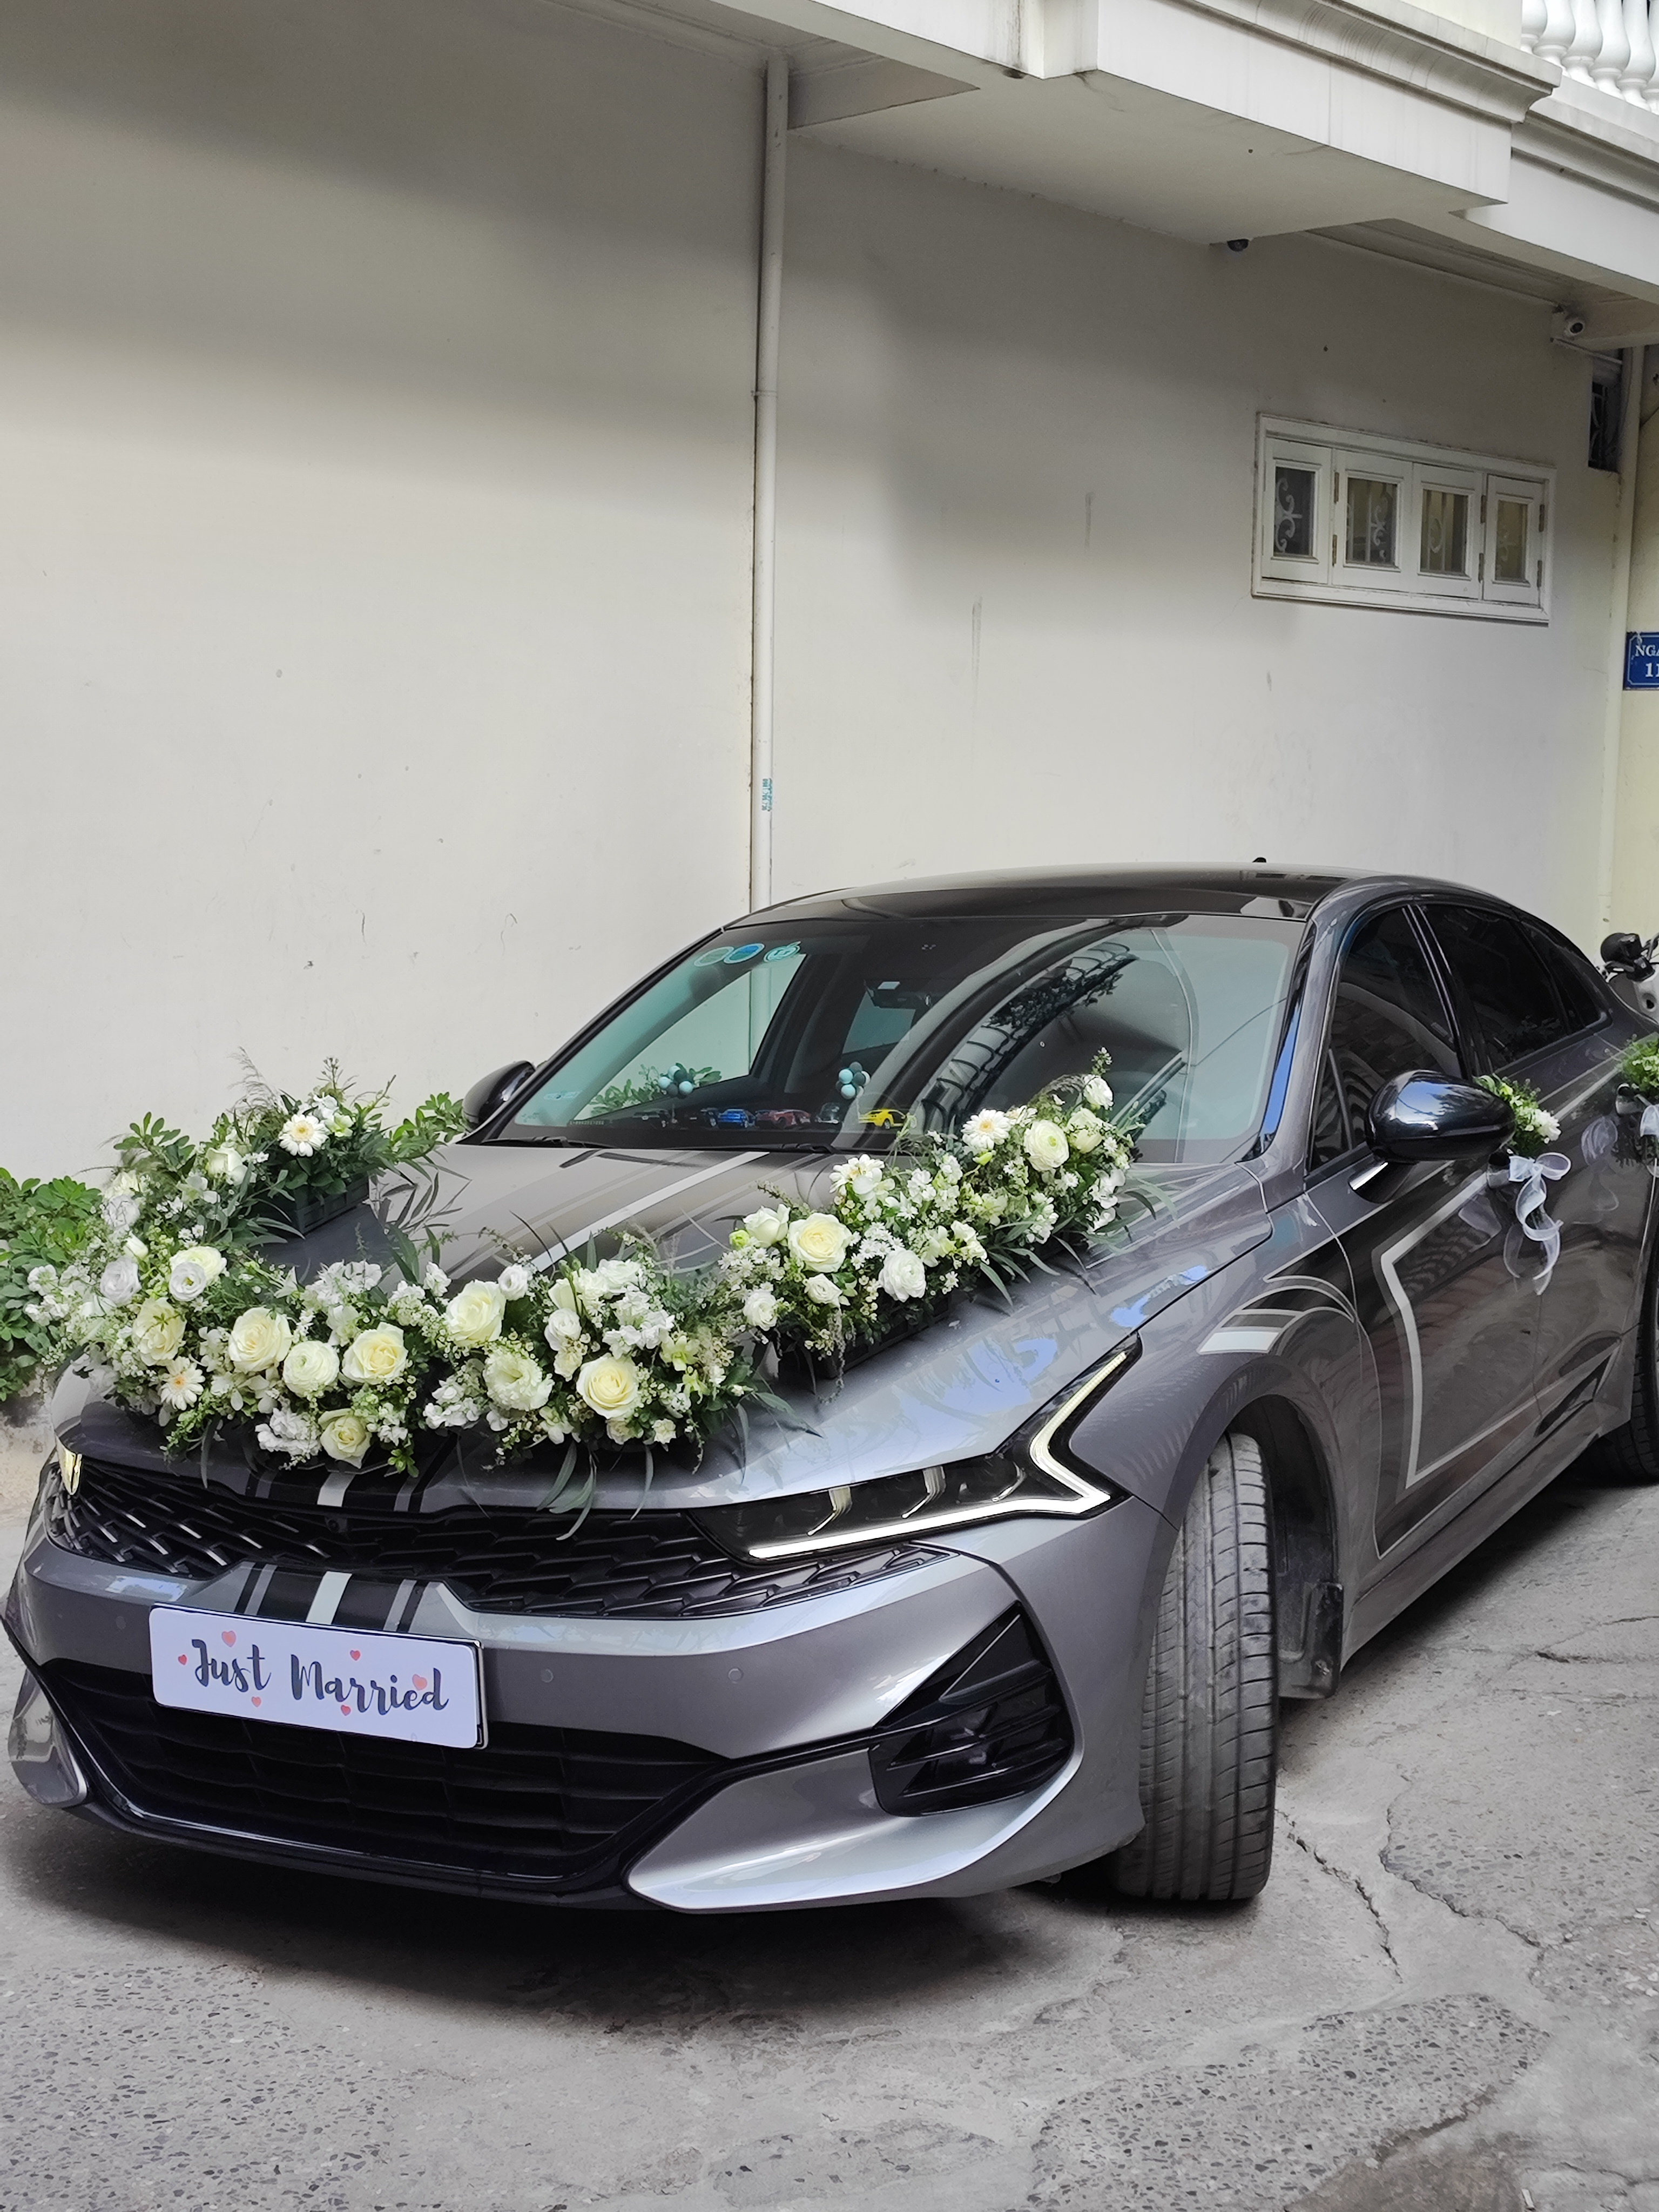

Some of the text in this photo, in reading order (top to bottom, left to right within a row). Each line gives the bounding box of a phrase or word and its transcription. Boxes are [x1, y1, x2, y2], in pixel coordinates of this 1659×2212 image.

[1635, 644, 1659, 657] NG
[191, 1639, 449, 1715] Just Married
